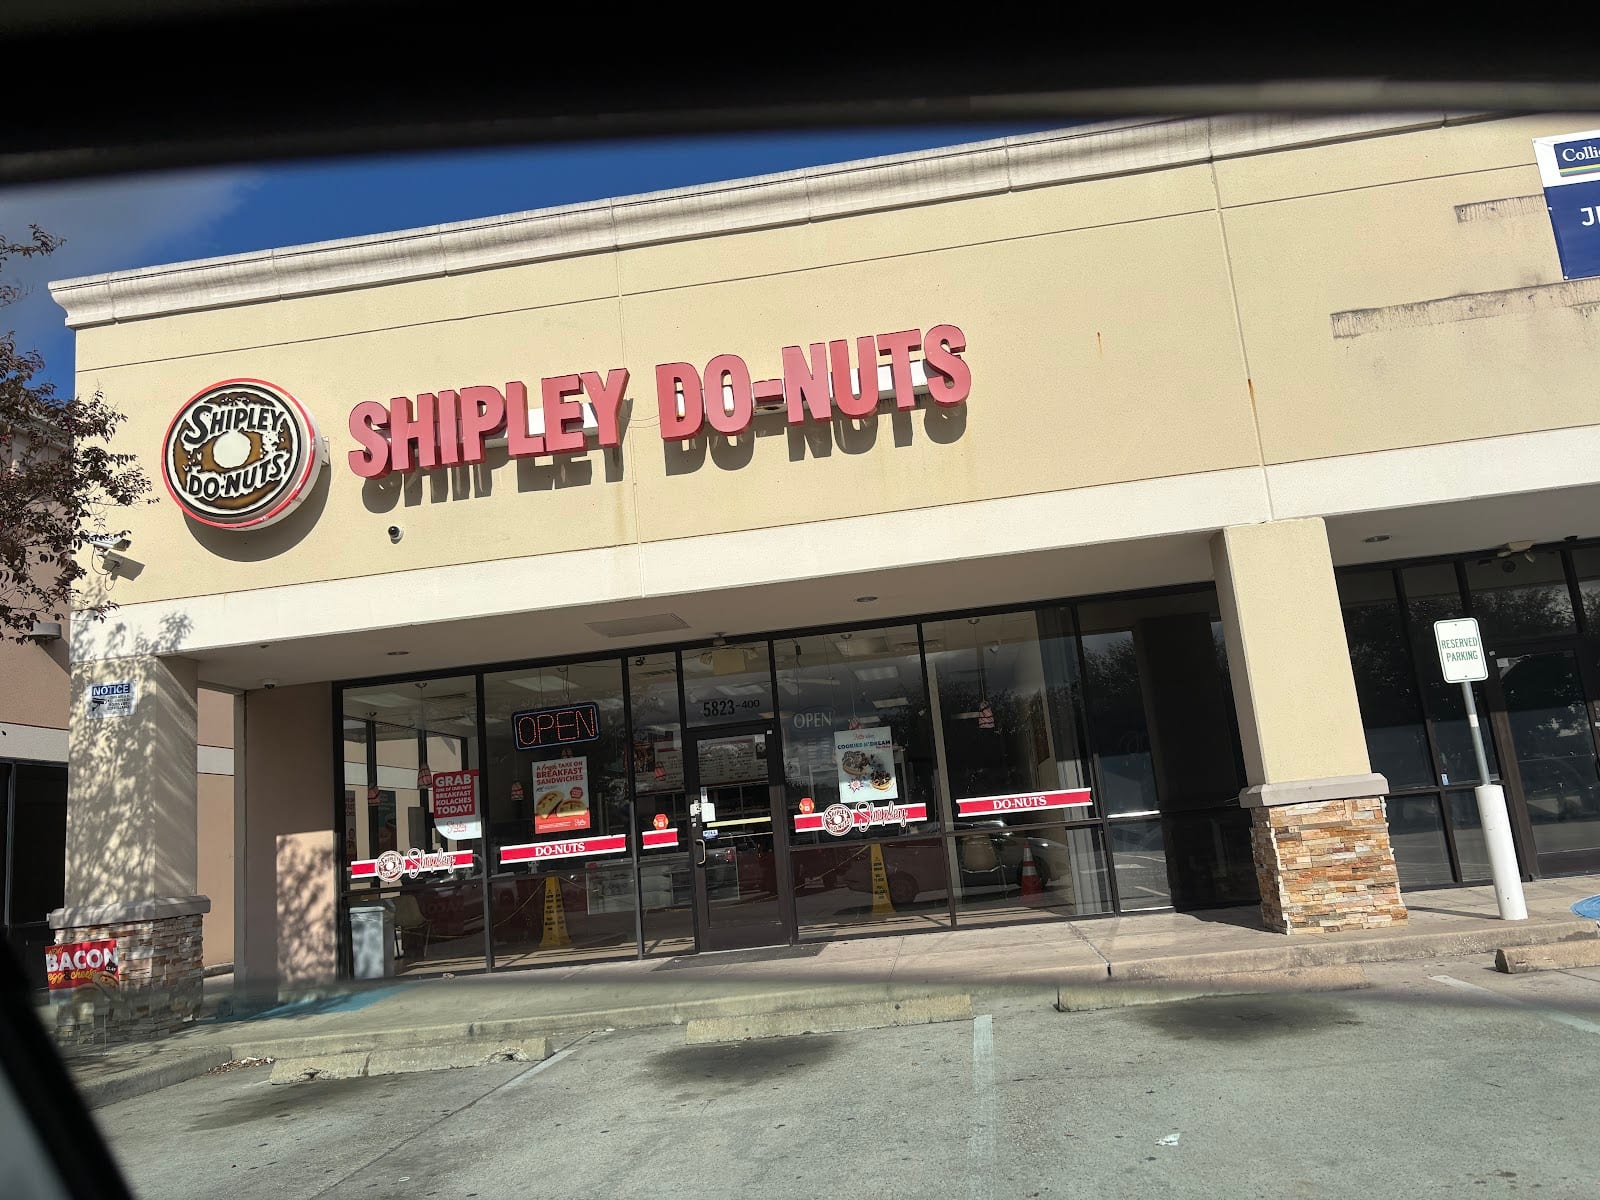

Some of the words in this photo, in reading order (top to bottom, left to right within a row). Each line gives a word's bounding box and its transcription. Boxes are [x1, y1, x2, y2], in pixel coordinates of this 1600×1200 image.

[1562, 146, 1600, 161] Colli
[348, 368, 630, 479] SHIPLEY
[655, 324, 971, 441] DO-NUTS
[184, 405, 284, 444] SHIPLEY
[189, 454, 283, 498] DO-NUTS
[1441, 637, 1478, 649] RESERVED
[1446, 651, 1478, 662] PARKING
[93, 684, 129, 695] NOTICE
[518, 708, 595, 745] OPEN
[793, 712, 832, 728] OPEN
[536, 767, 583, 778] BREAKFAST
[435, 774, 472, 787] GRAB
[536, 775, 584, 785] SANDWICHES
[436, 790, 471, 799] BREAKFAST
[436, 797, 472, 806] KOLACHES
[993, 796, 1047, 809] DO-NUTS
[437, 804, 472, 815] TODAY!
[535, 842, 585, 856] DO-NUTS
[46, 947, 119, 972] BACON
